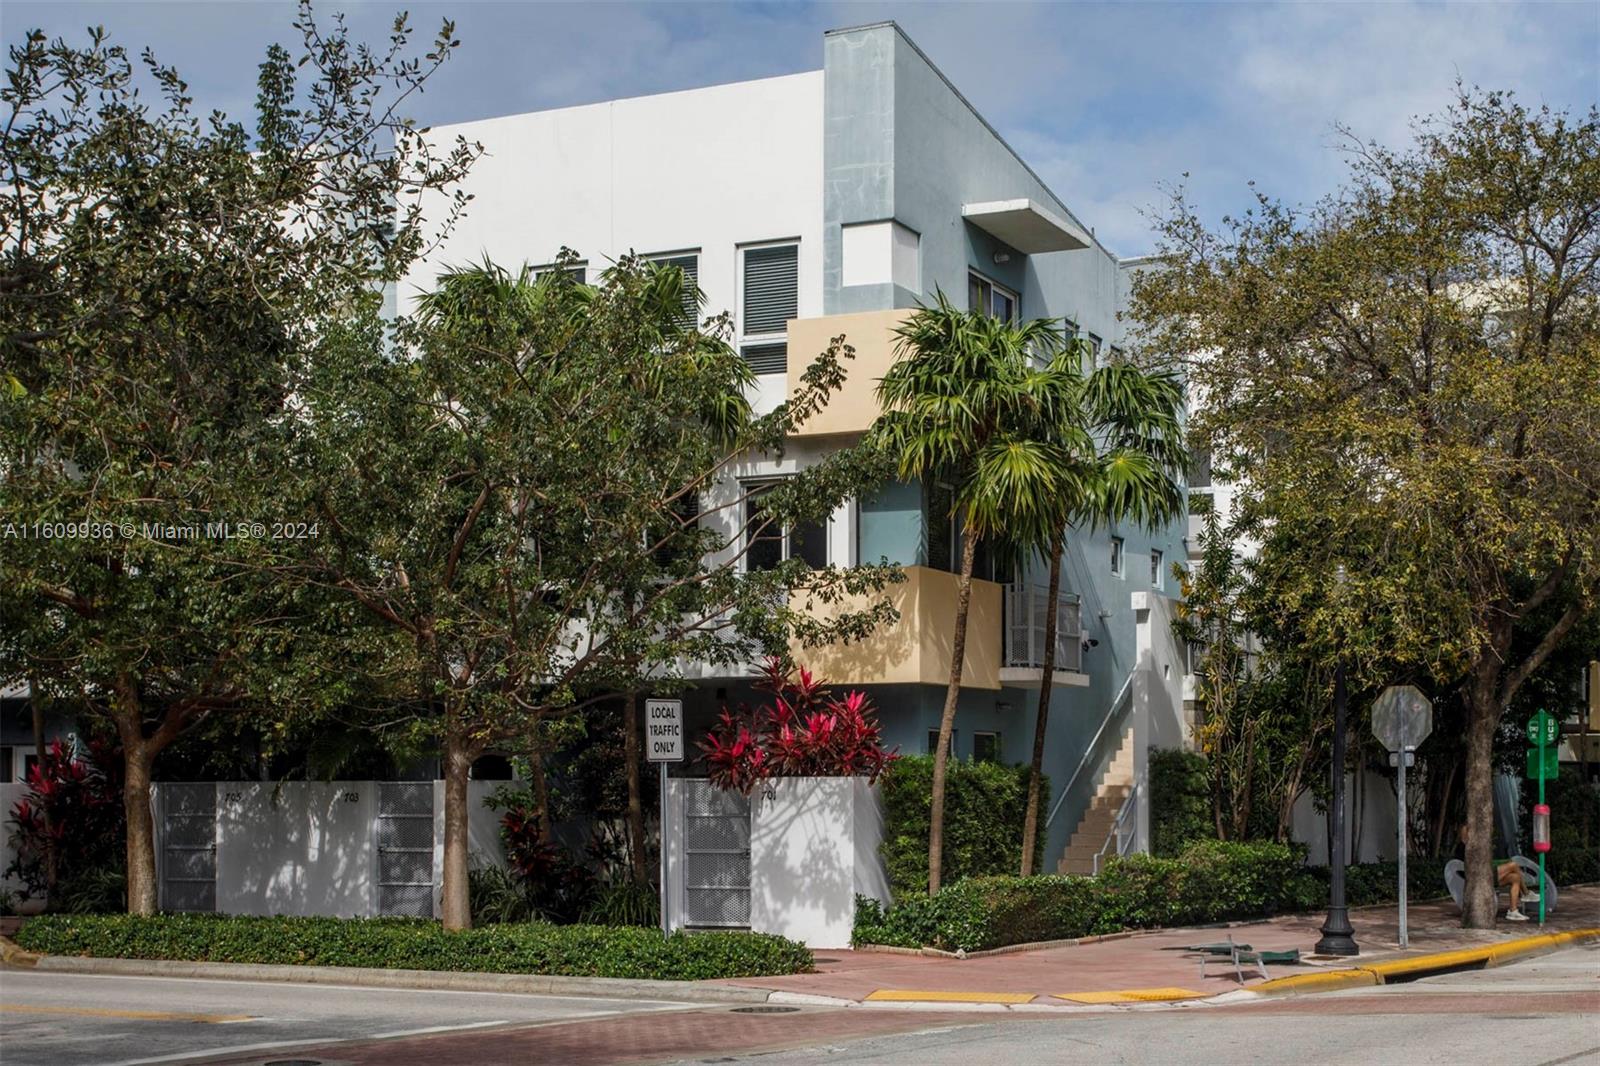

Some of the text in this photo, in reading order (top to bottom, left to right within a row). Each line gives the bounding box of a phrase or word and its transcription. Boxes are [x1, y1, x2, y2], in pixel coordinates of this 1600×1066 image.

[651, 707, 676, 719] LOCAL
[650, 724, 680, 736] TRAFFIC
[654, 741, 675, 753] ONLY
[344, 792, 359, 802] 703
[761, 790, 776, 801] 701
